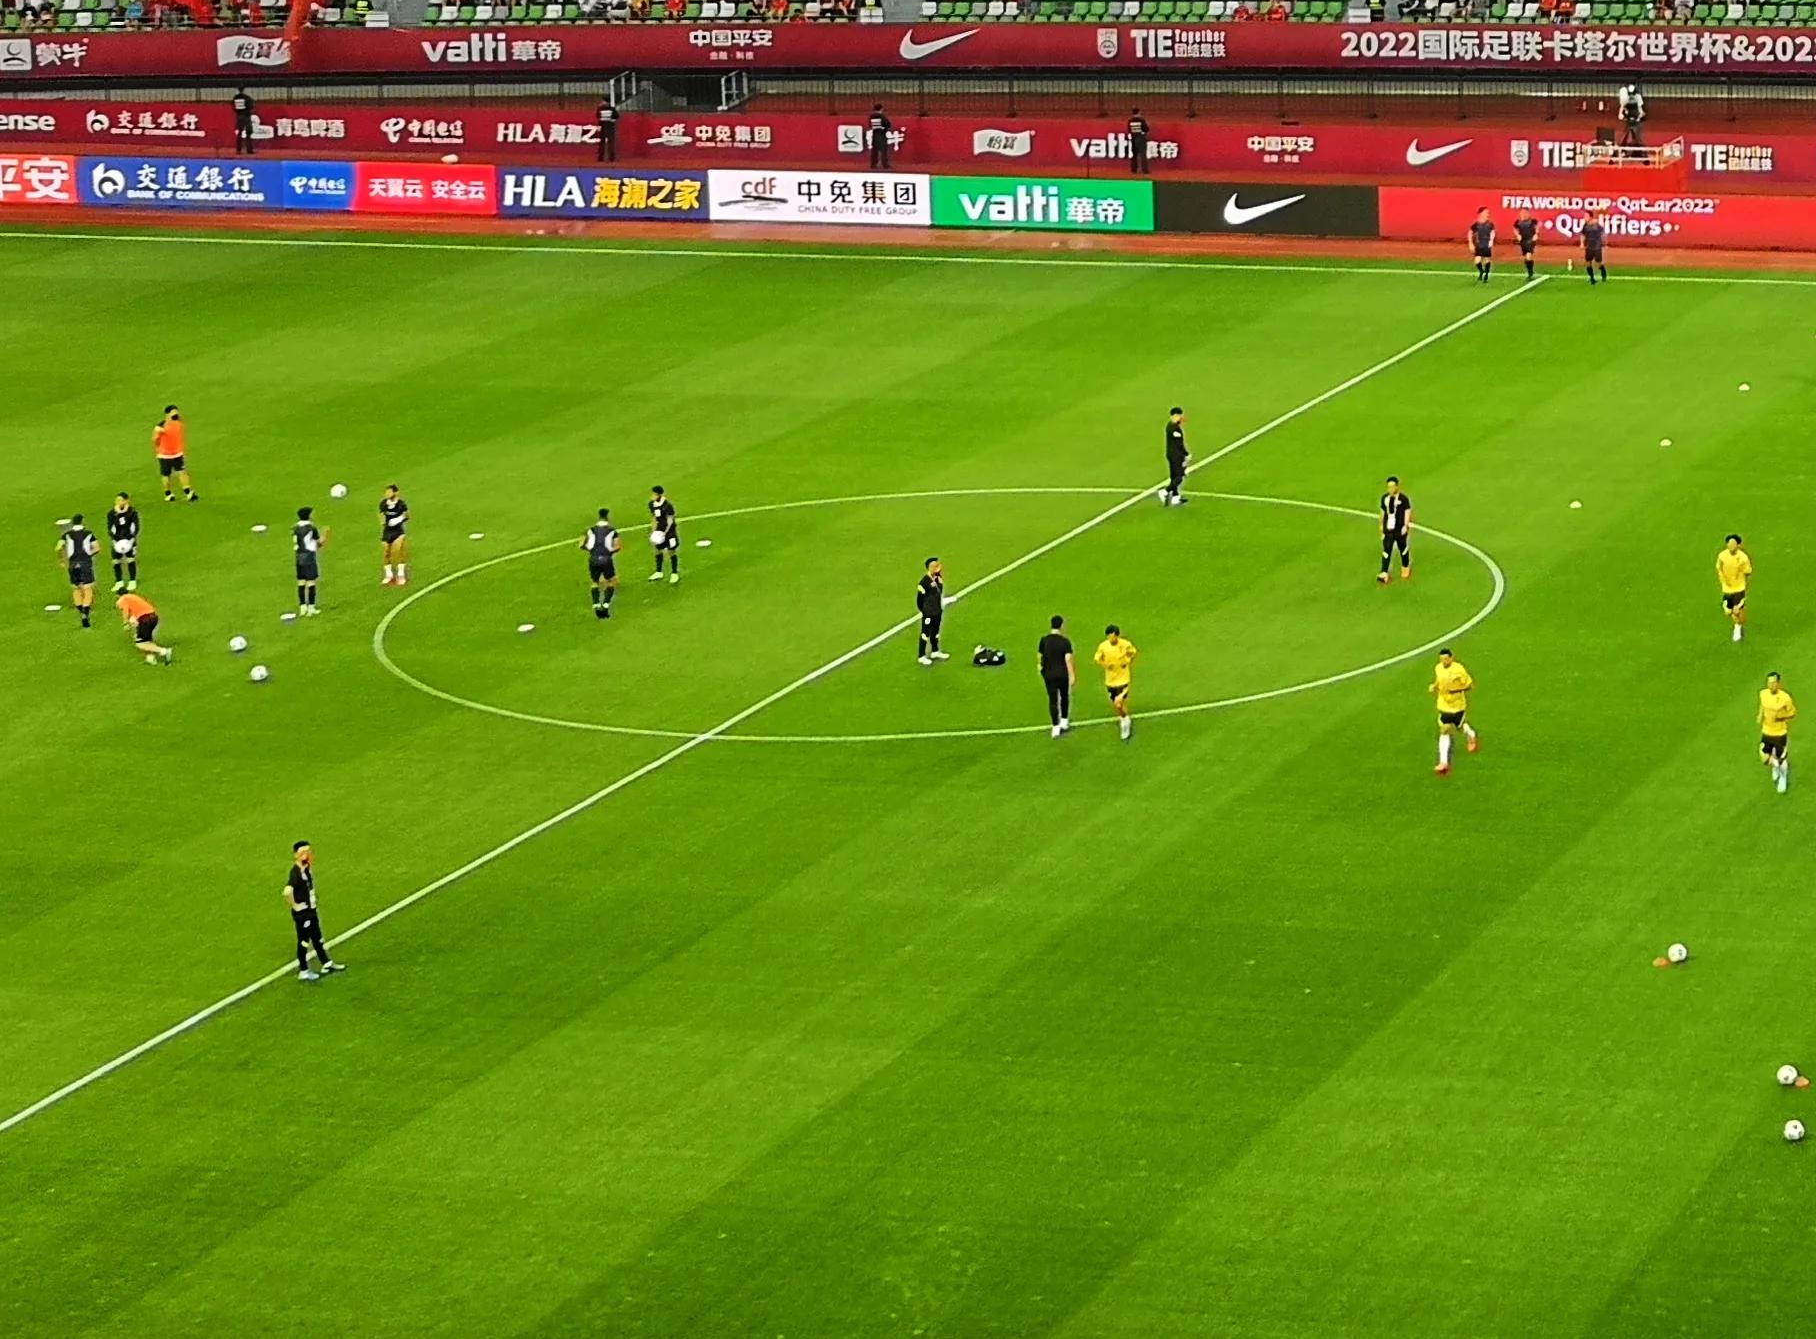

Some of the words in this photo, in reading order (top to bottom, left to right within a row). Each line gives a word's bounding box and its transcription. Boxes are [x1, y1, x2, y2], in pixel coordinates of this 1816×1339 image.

[421, 33, 507, 62] vatti
[689, 29, 773, 47] 中国平安
[1130, 29, 1172, 58] TIE
[496, 123, 545, 143] HLA
[695, 124, 771, 142] 中免集团
[1247, 136, 1314, 152] 中国平安
[1539, 141, 1574, 168] TIE
[1691, 144, 1727, 171] TIE
[136, 164, 254, 191] 交通銀行
[368, 178, 424, 198] 天翼云
[431, 180, 485, 201] 安全云
[741, 177, 776, 195] cdf
[504, 174, 586, 208] HLA
[591, 177, 702, 210] 海澜之家
[797, 179, 917, 205] 中免集团
[958, 185, 1059, 223] vatti
[1502, 195, 1533, 209] FIFA
[1533, 196, 1583, 210] WORLD
[798, 205, 828, 213] CHINA
[831, 205, 856, 214] DUTY
[859, 205, 884, 214] FREE
[886, 206, 918, 216] GROUP
[1065, 198, 1126, 224] 華帝
[1555, 214, 1662, 238] Qulifiers
